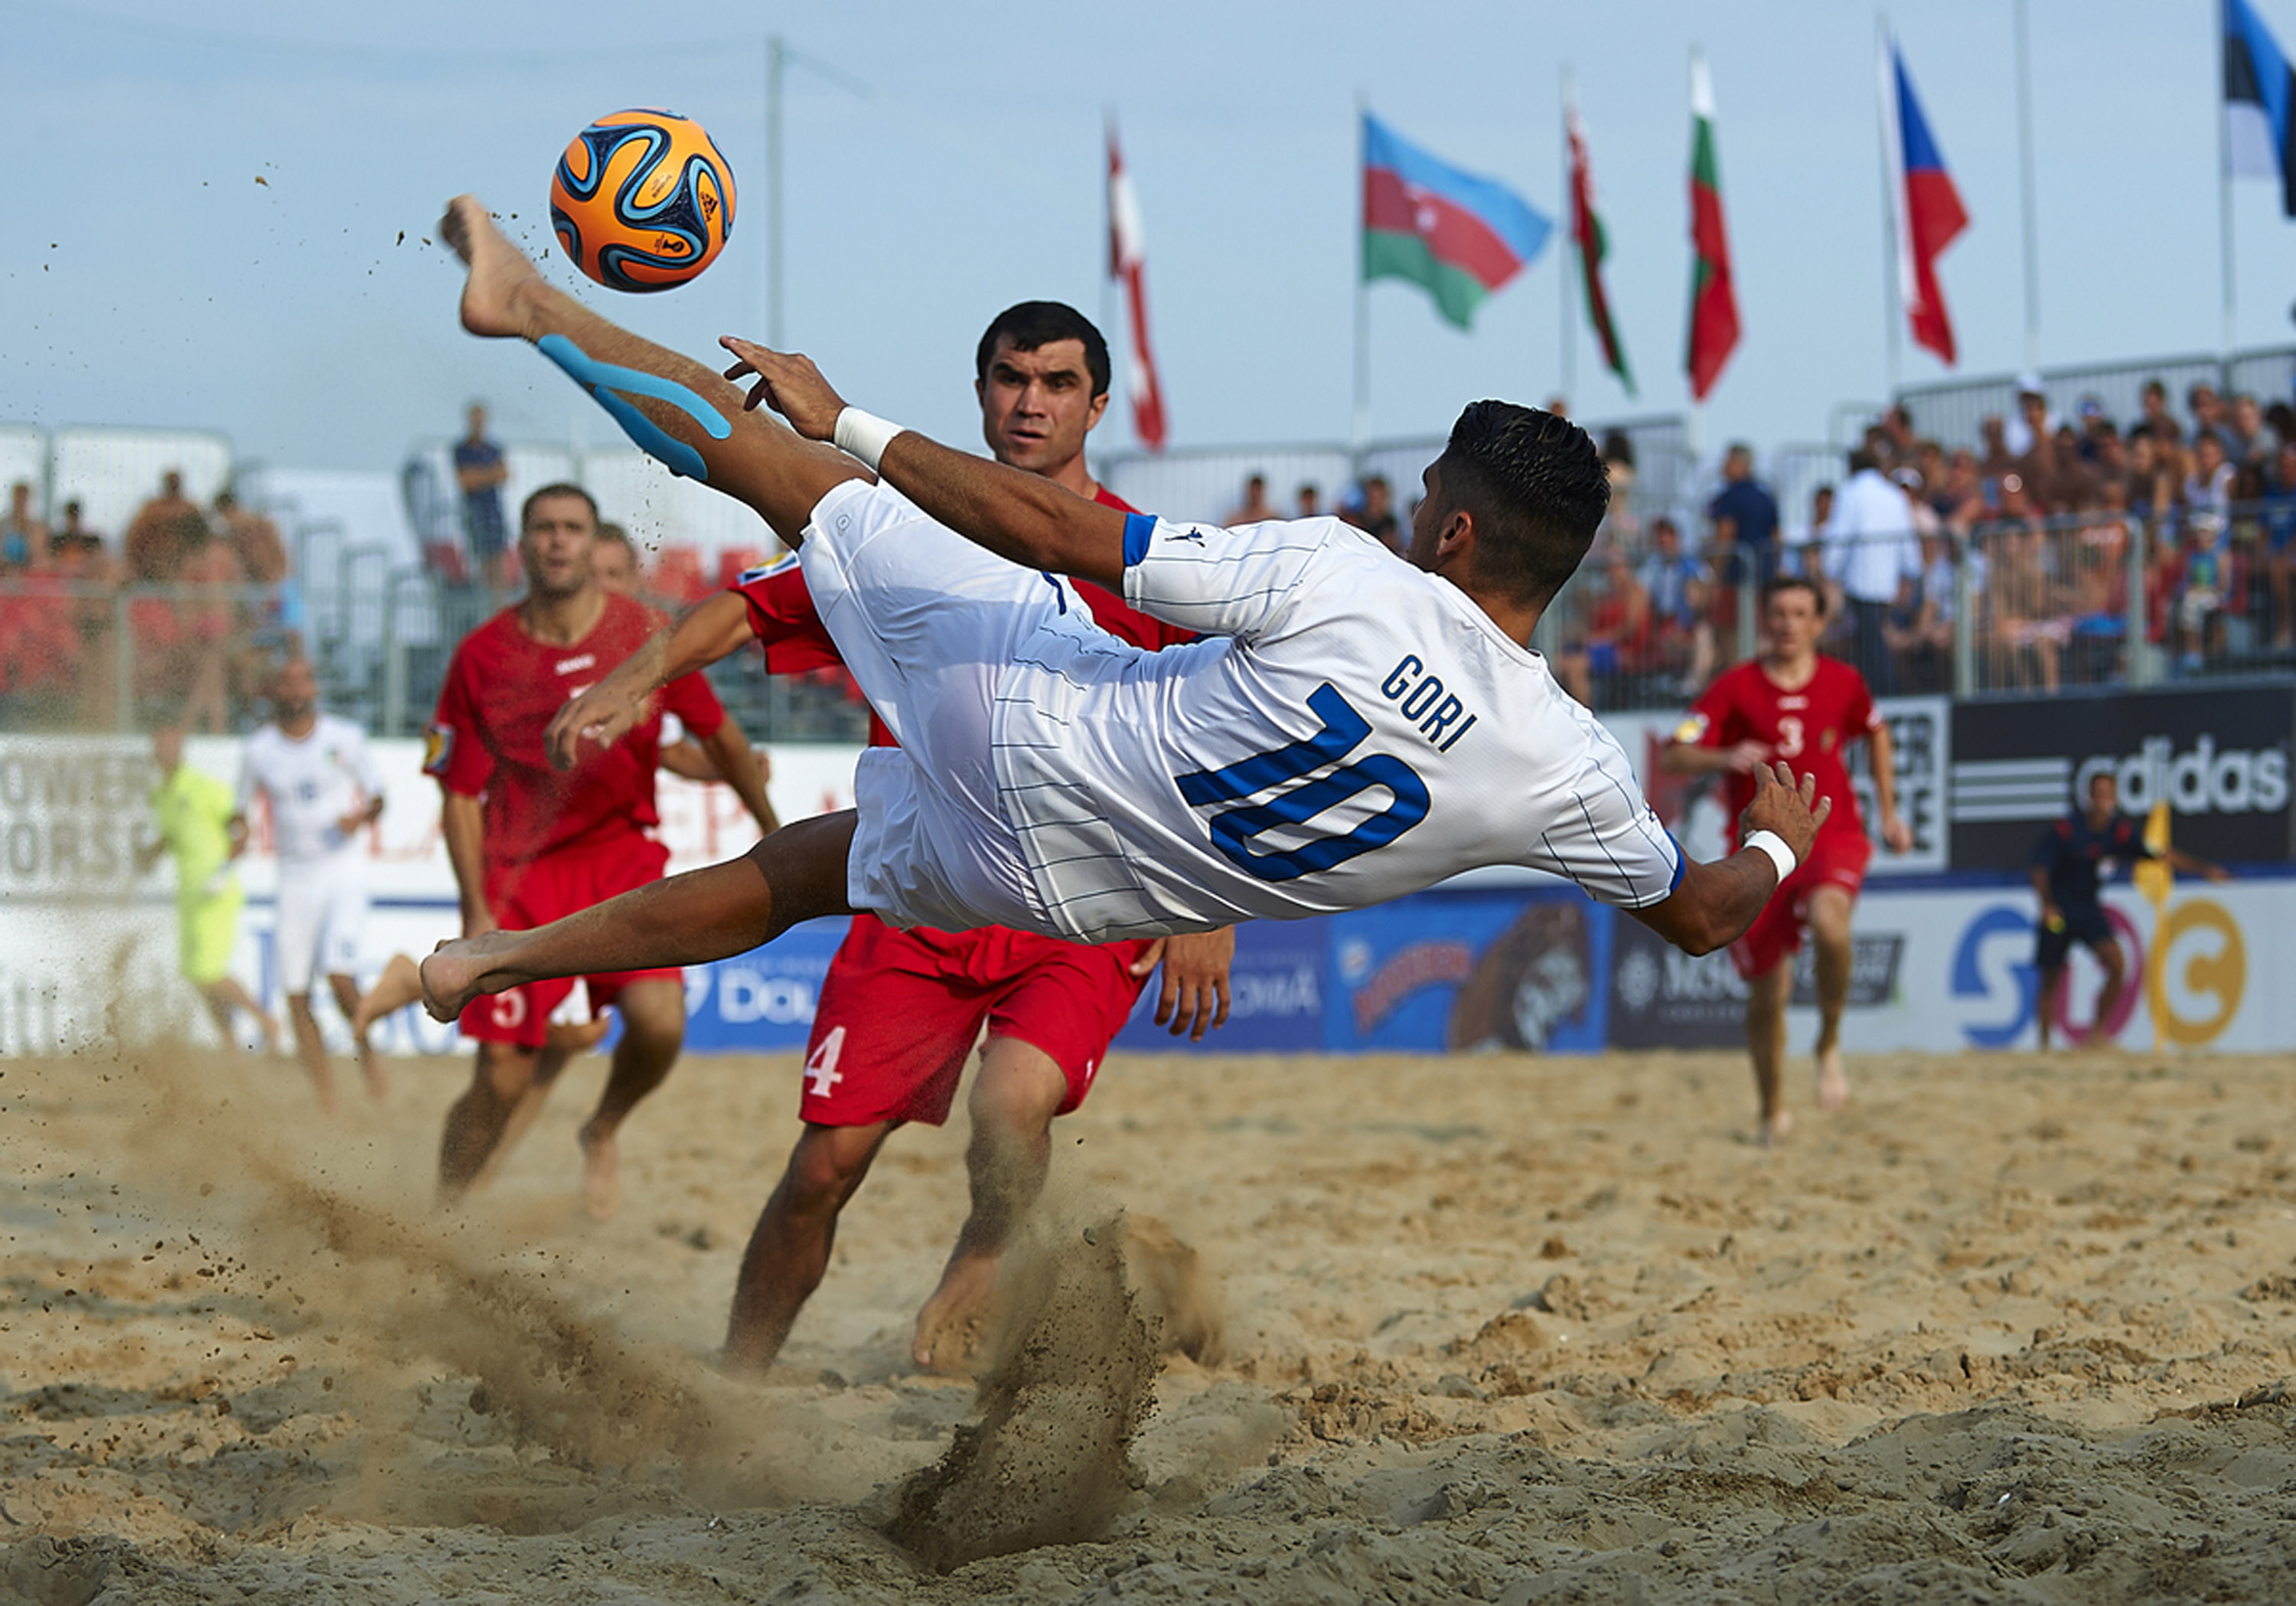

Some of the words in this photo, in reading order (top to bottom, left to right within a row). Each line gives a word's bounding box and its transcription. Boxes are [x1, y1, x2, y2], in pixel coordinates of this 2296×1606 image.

[1381, 654, 1478, 753] GORI
[1776, 715, 1805, 759] 3
[1174, 681, 1431, 882] 10
[804, 1025, 846, 1098] 4
